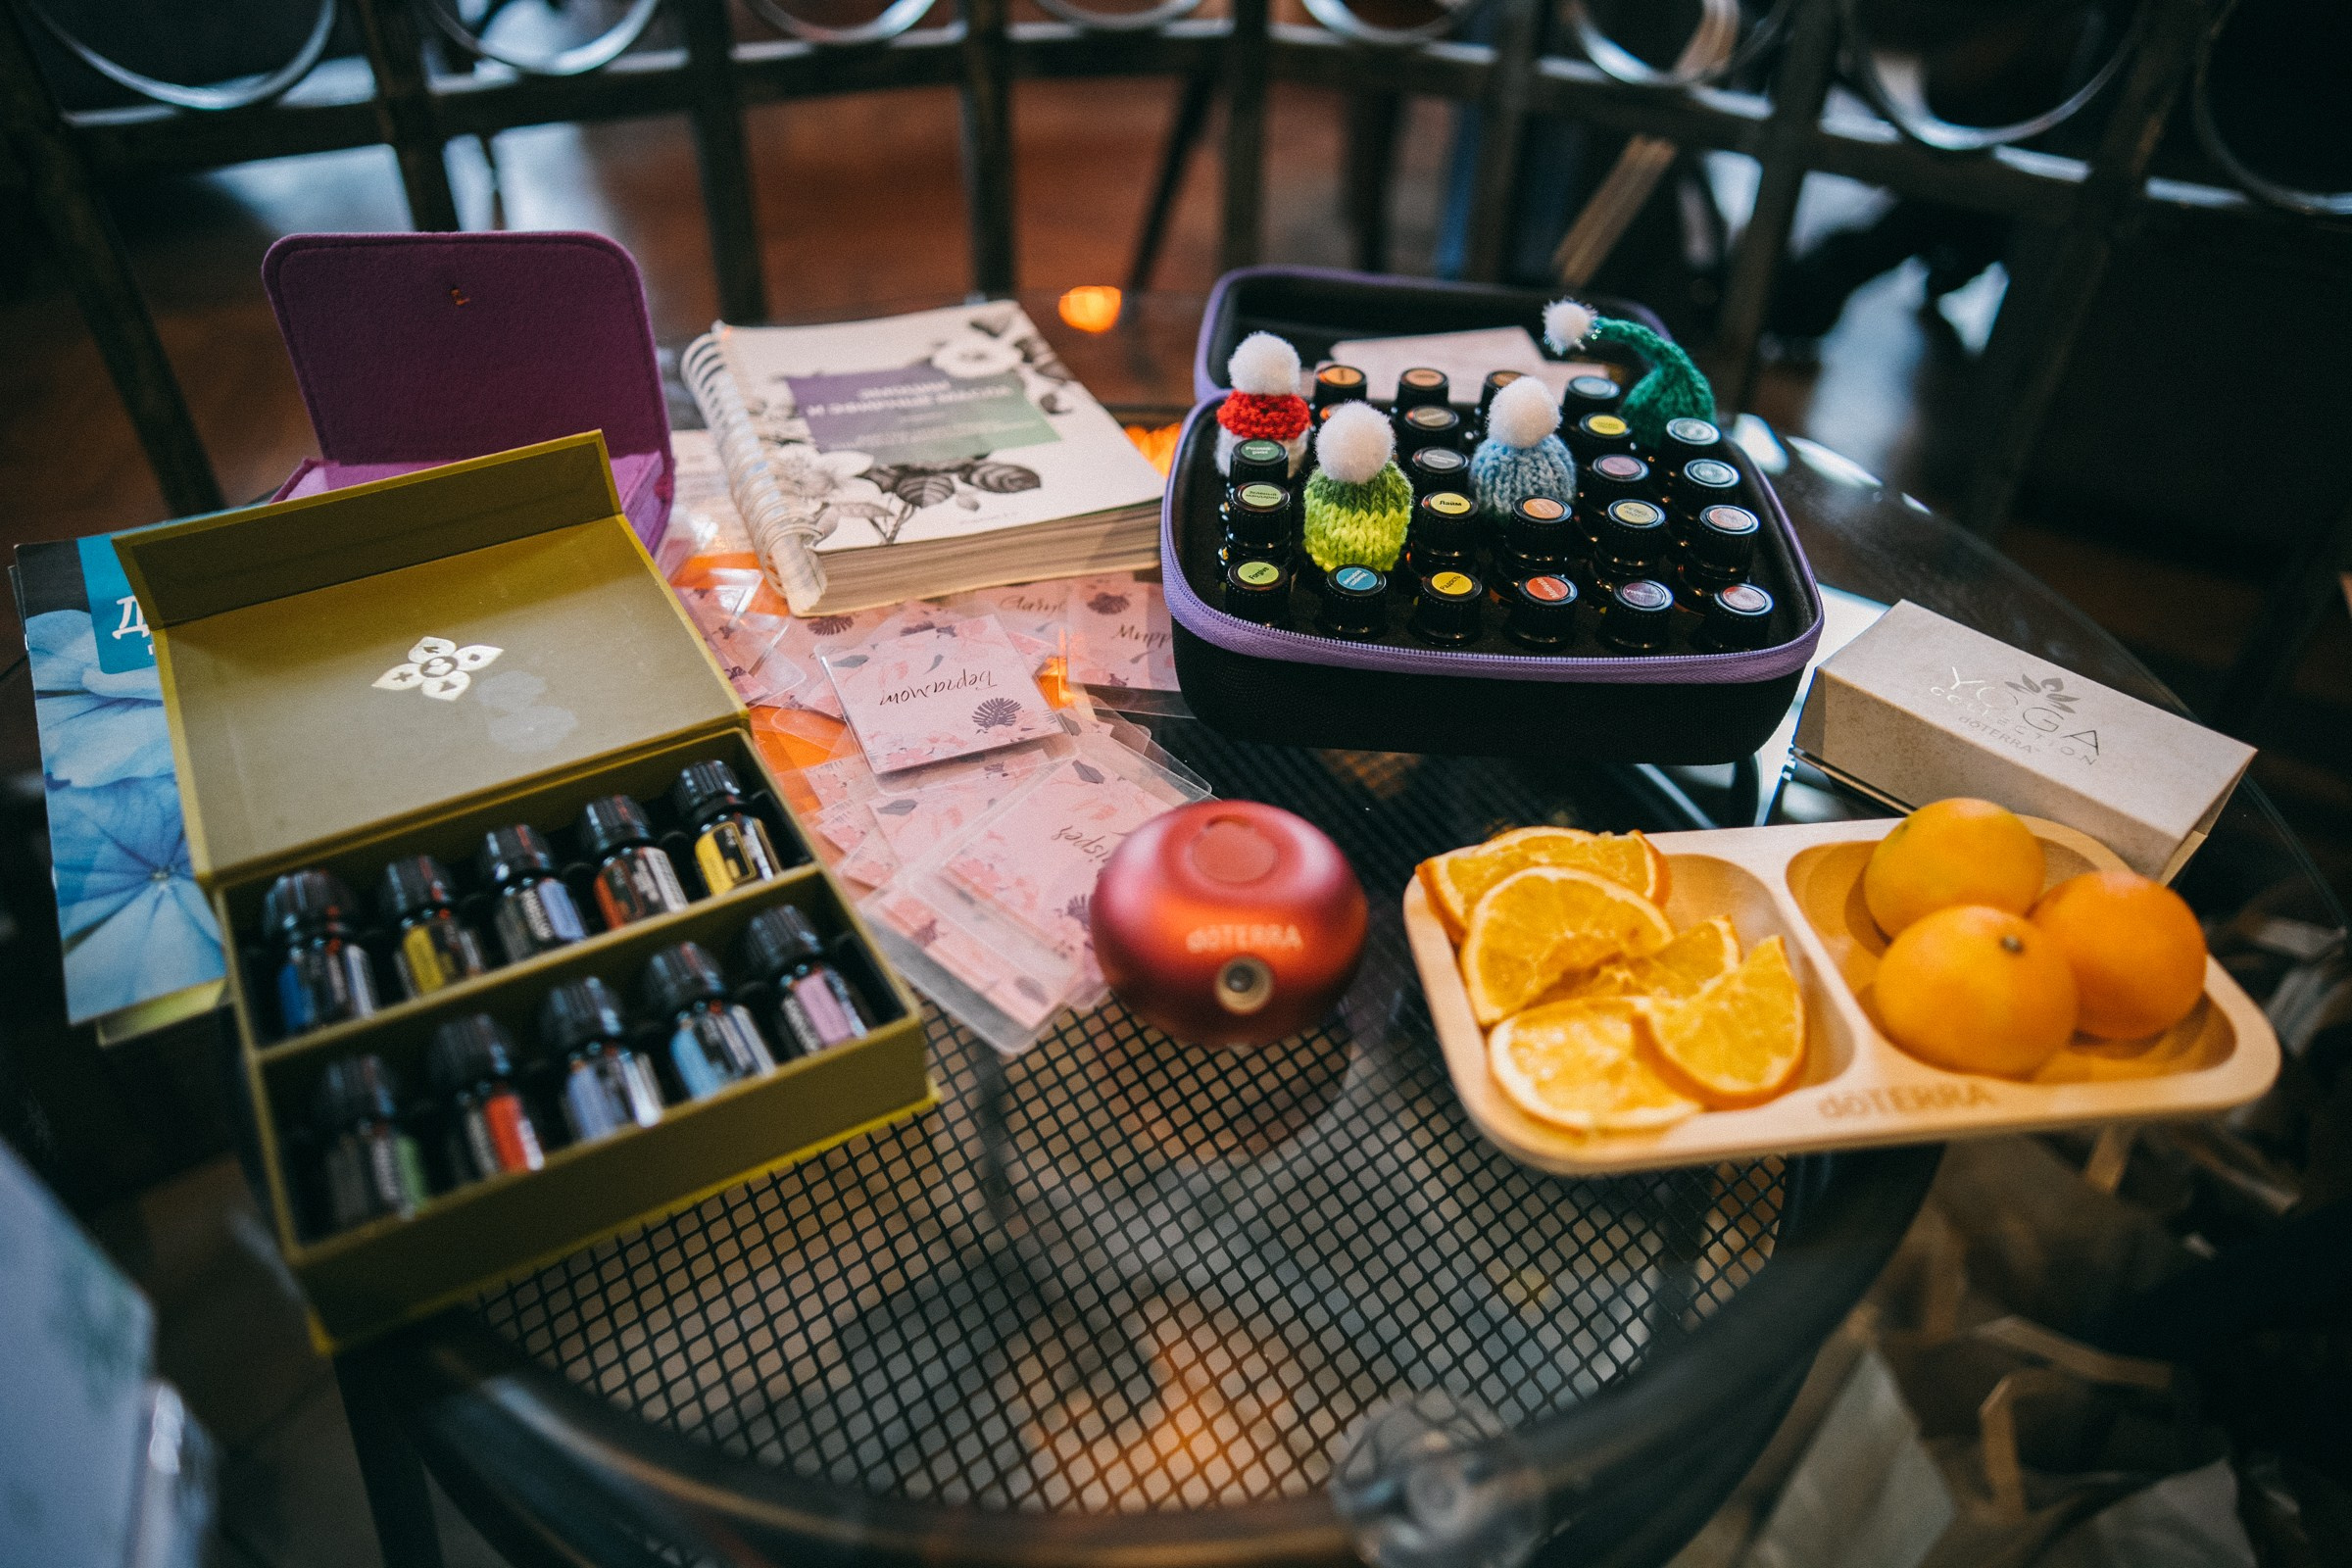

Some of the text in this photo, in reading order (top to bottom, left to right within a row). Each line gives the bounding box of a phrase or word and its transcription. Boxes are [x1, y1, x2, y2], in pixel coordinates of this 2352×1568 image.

[1249, 565, 1270, 580] Forgive
[879, 668, 998, 706] Бергамот
[1950, 666, 2100, 756] YOGA
